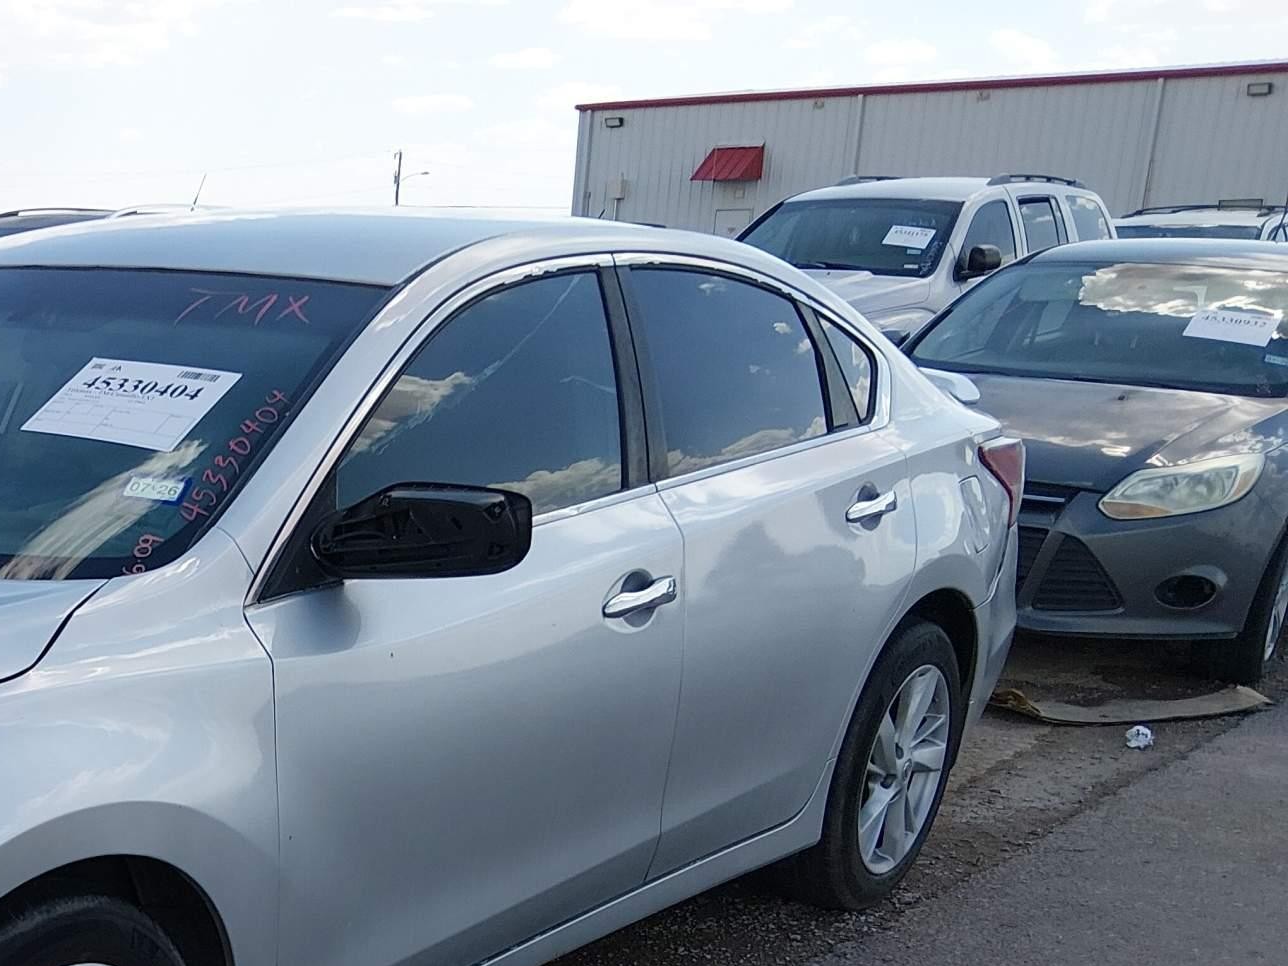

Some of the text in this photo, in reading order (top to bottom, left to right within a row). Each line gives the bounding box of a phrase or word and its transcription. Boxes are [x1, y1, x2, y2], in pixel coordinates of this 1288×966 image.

[174, 287, 310, 327] TMX
[83, 376, 205, 401] 45330404
[180, 389, 291, 522] 45330404
[129, 481, 179, 496] 07 26
